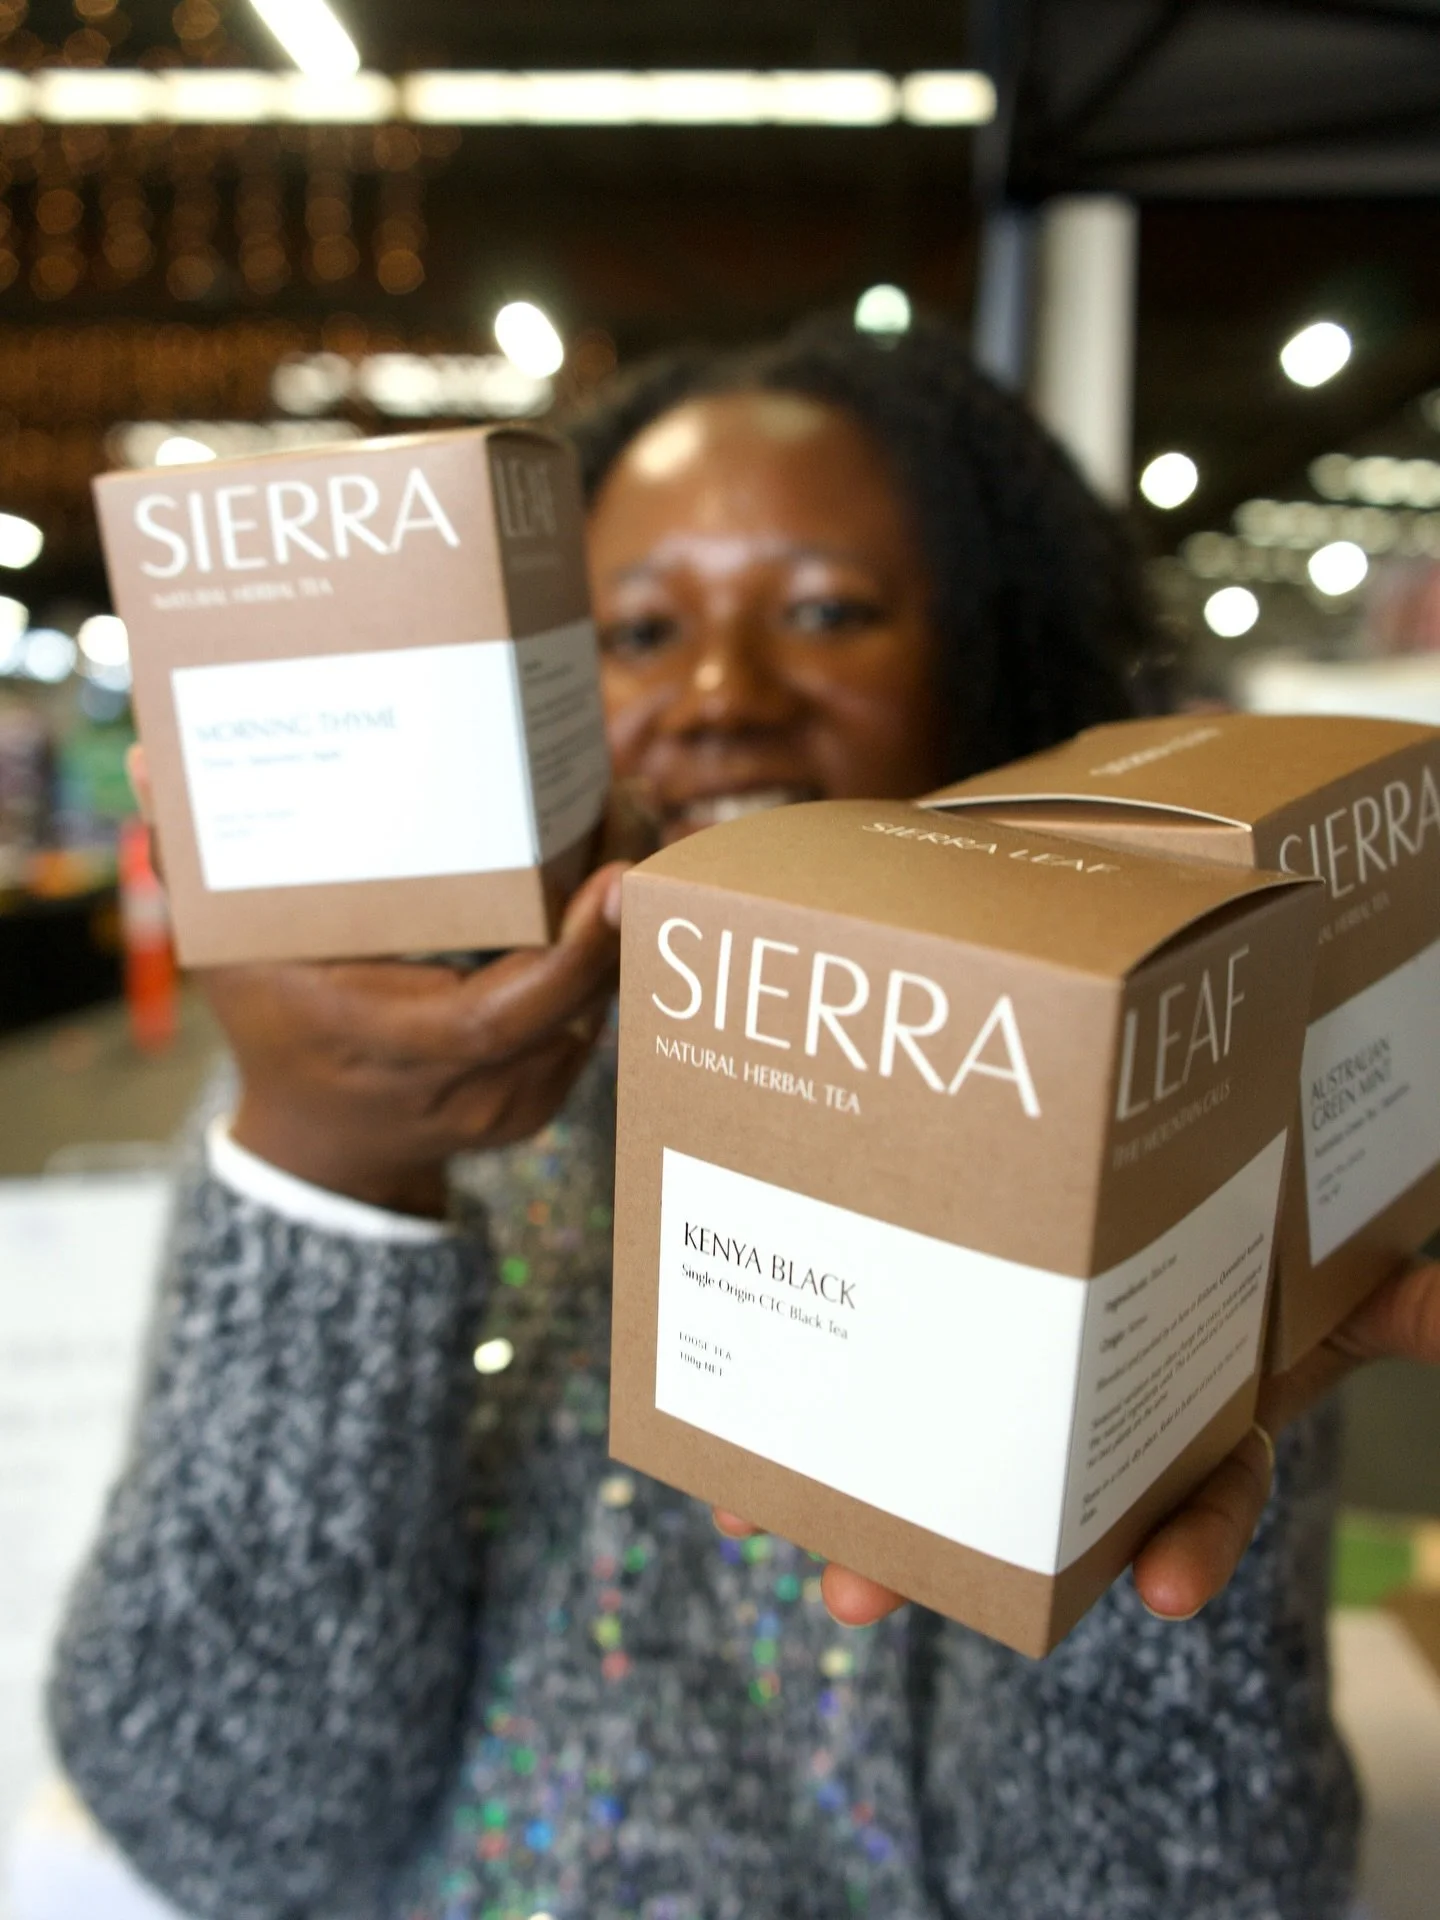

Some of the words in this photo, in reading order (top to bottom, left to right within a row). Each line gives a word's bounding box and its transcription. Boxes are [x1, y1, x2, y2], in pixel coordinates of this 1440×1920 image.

[133, 467, 460, 578] SIERRA
[195, 716, 311, 742] MORNING
[318, 705, 397, 732] THYME
[862, 821, 997, 856] SIERRA
[1009, 849, 1121, 875] LEAF
[652, 917, 1040, 1118] SIERRA
[1116, 944, 1249, 1120] LEAF
[656, 1035, 737, 1080] NATURAL
[743, 1063, 817, 1103] HERBAL
[825, 1084, 861, 1115] TEA
[1310, 1035, 1392, 1106] AUSTRALIAN
[681, 1263, 715, 1289] Single
[719, 1279, 756, 1304] Origin
[759, 1293, 785, 1315] CTC
[790, 1305, 822, 1329] Black
[828, 1320, 848, 1340] Tea
[684, 1221, 762, 1274] KENYA
[771, 1254, 856, 1309] BLACK
[679, 1331, 709, 1351] LOOSE
[714, 1344, 732, 1361] TEA
